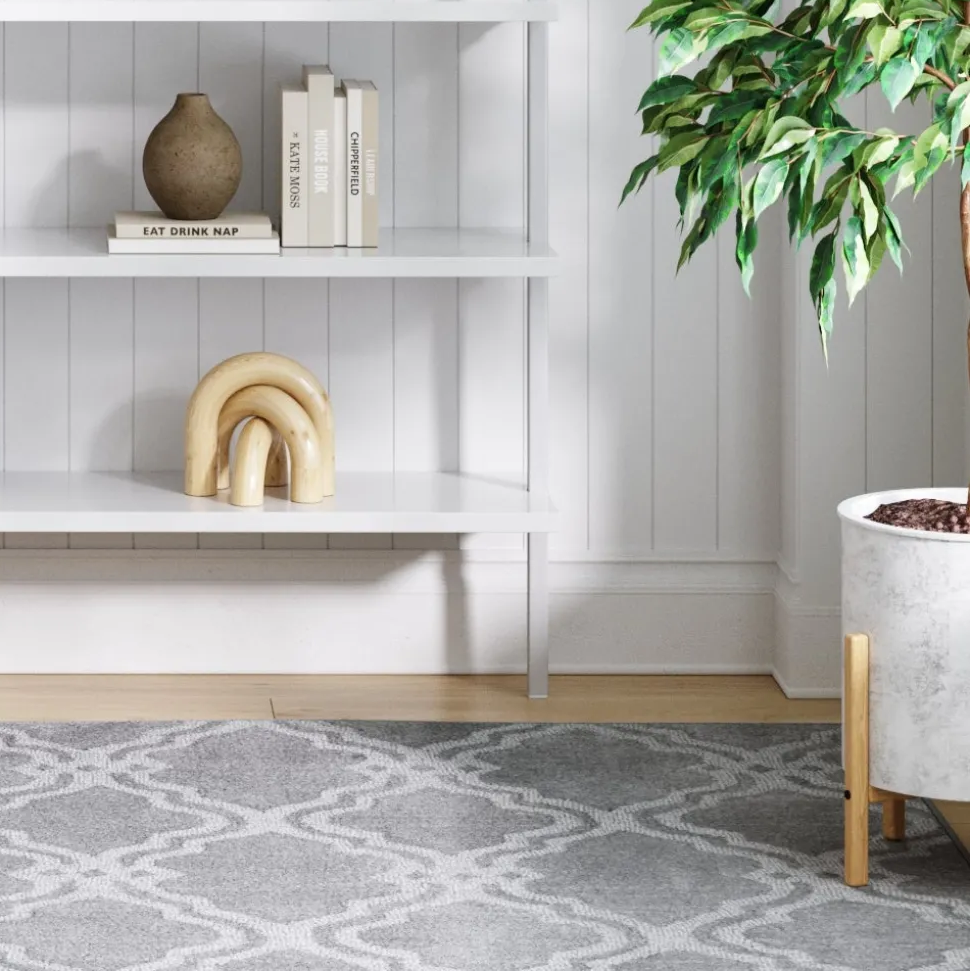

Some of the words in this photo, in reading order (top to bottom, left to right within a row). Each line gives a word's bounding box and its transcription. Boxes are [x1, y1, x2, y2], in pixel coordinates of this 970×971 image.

[289, 142, 300, 173] KATE
[350, 131, 360, 196] CHIPPERFIELD
[289, 176, 300, 209] MOSS
[314, 165, 329, 194] BOOK
[143, 227, 165, 236] EAT
[170, 227, 209, 236] DRINK
[213, 227, 239, 237] NAP
